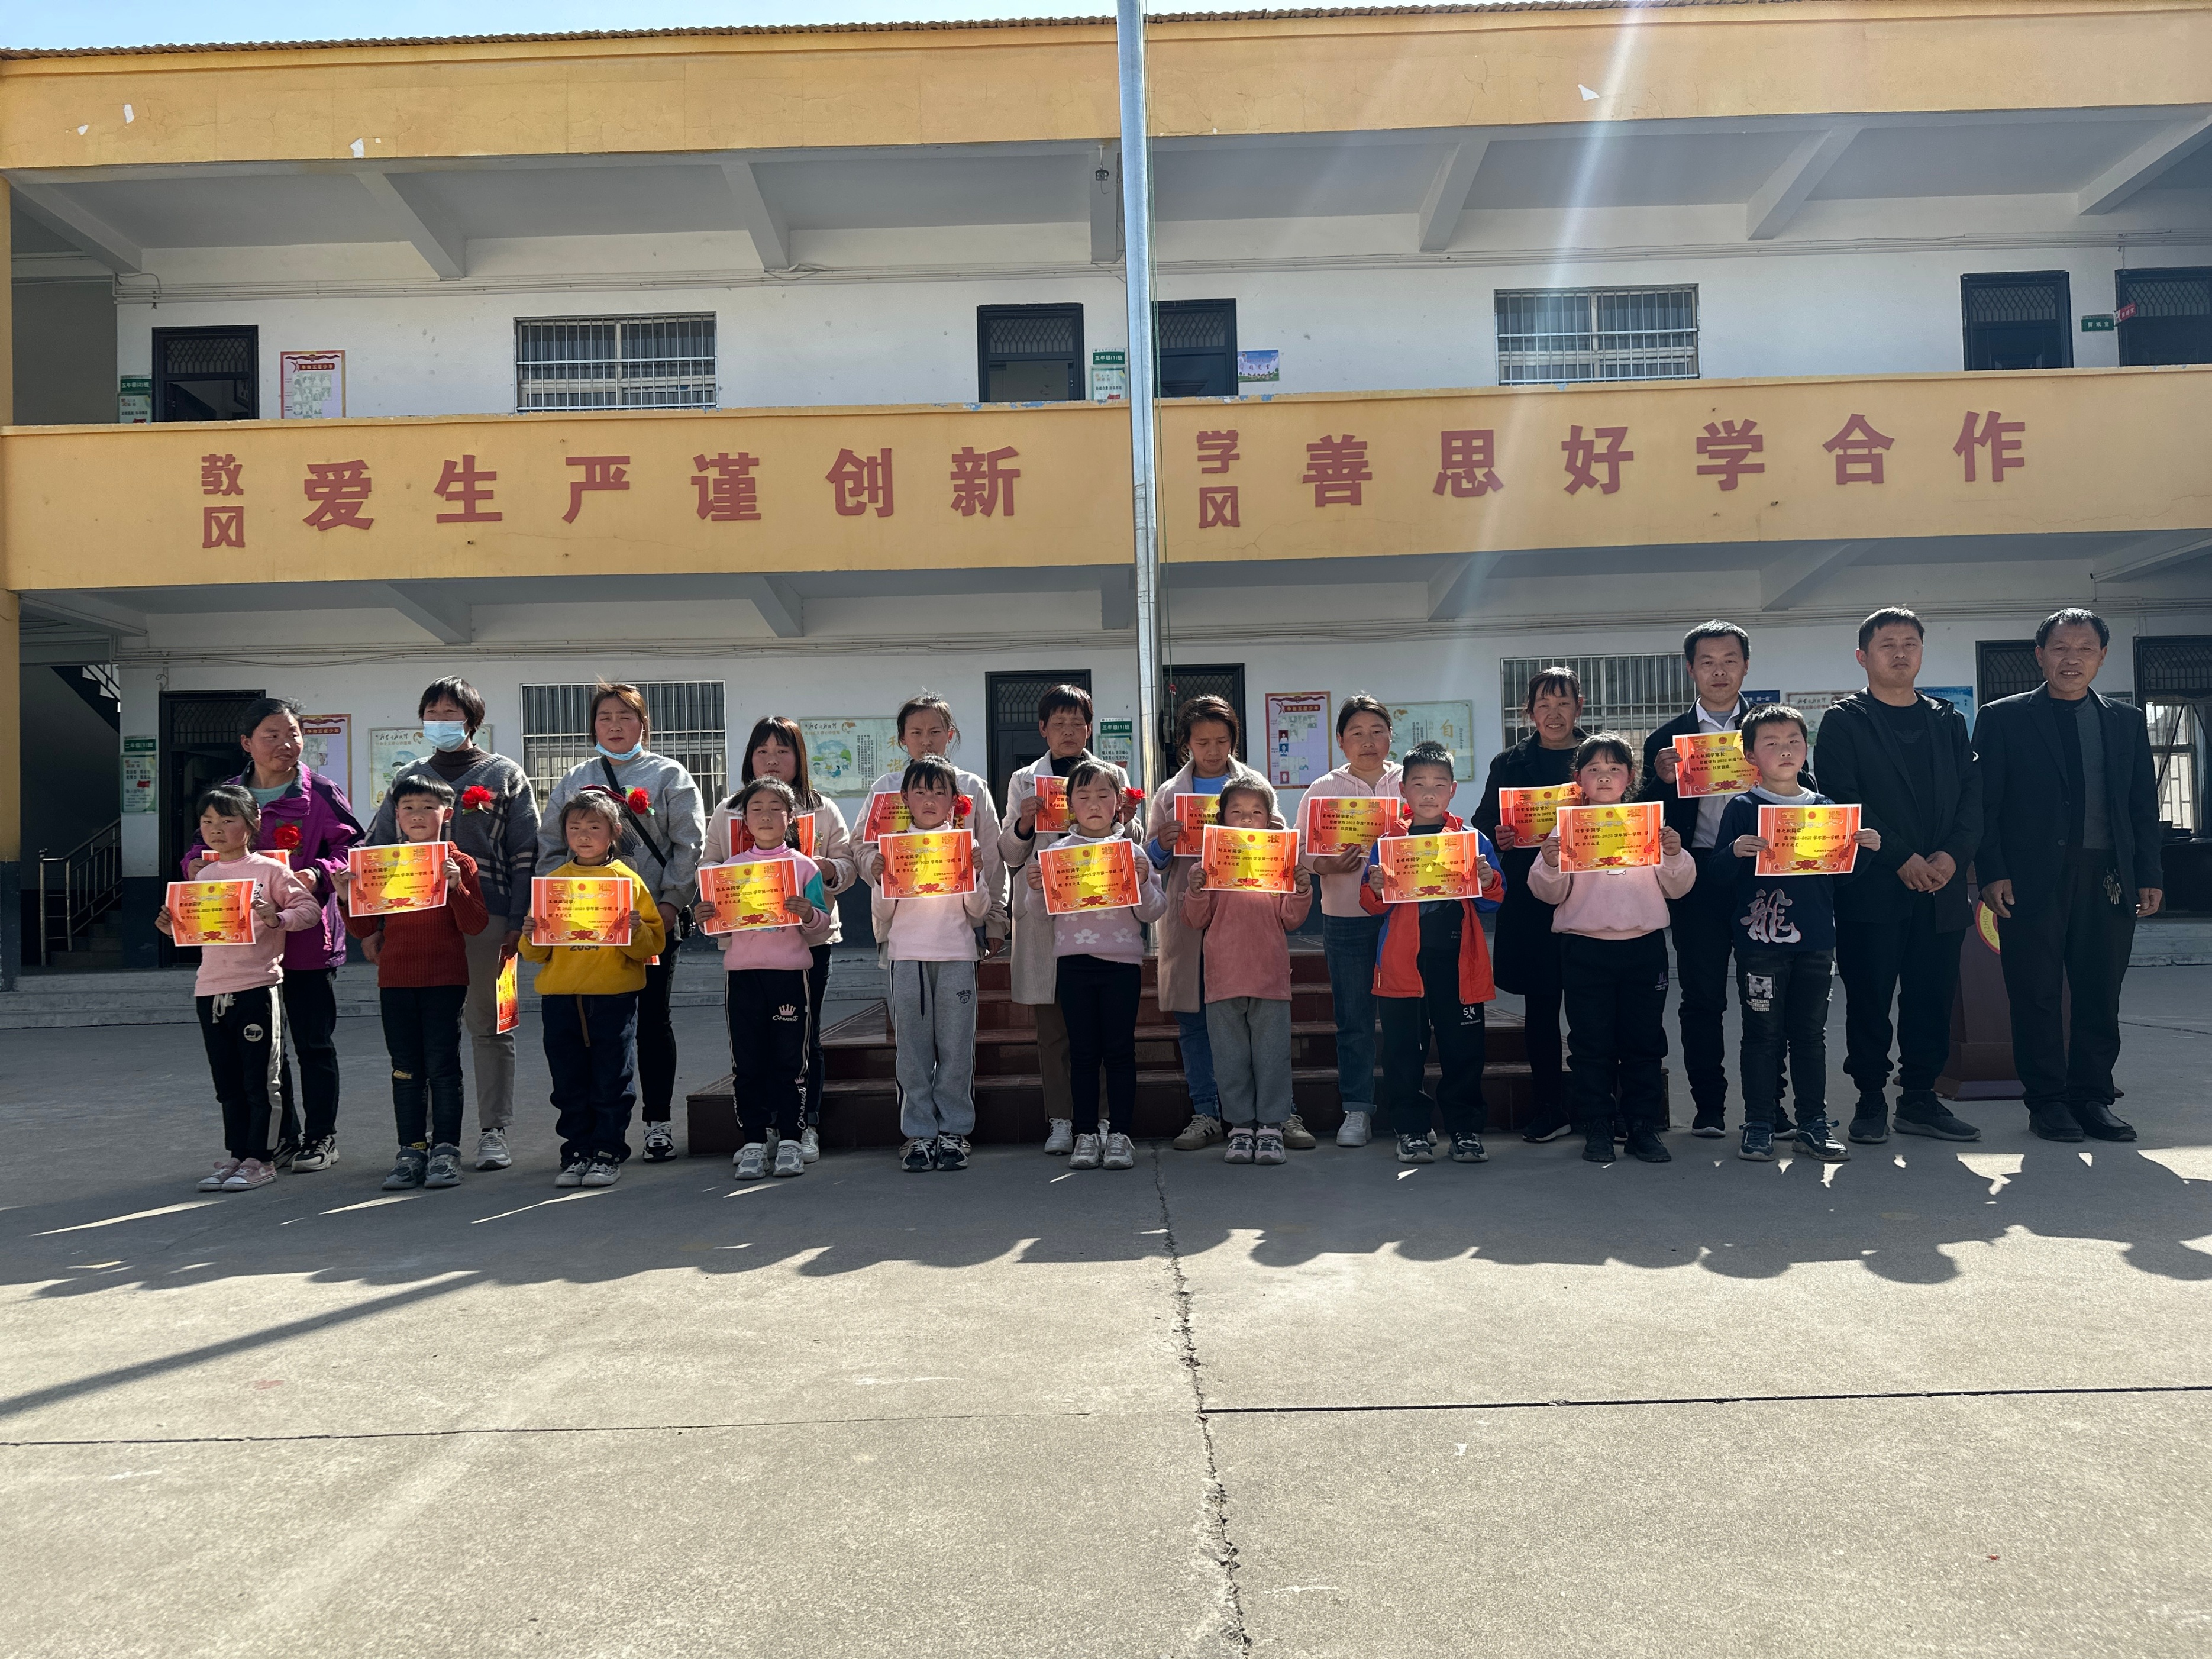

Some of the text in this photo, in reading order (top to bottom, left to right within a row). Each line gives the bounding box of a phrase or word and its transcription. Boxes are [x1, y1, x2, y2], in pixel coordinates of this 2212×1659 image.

[201, 453, 245, 548] 教风
[304, 446, 1020, 531] 爱生严谨创新
[1196, 430, 1240, 528] 学风
[1302, 411, 2025, 507] 善思好学合作
[1740, 888, 1801, 943] 龍
